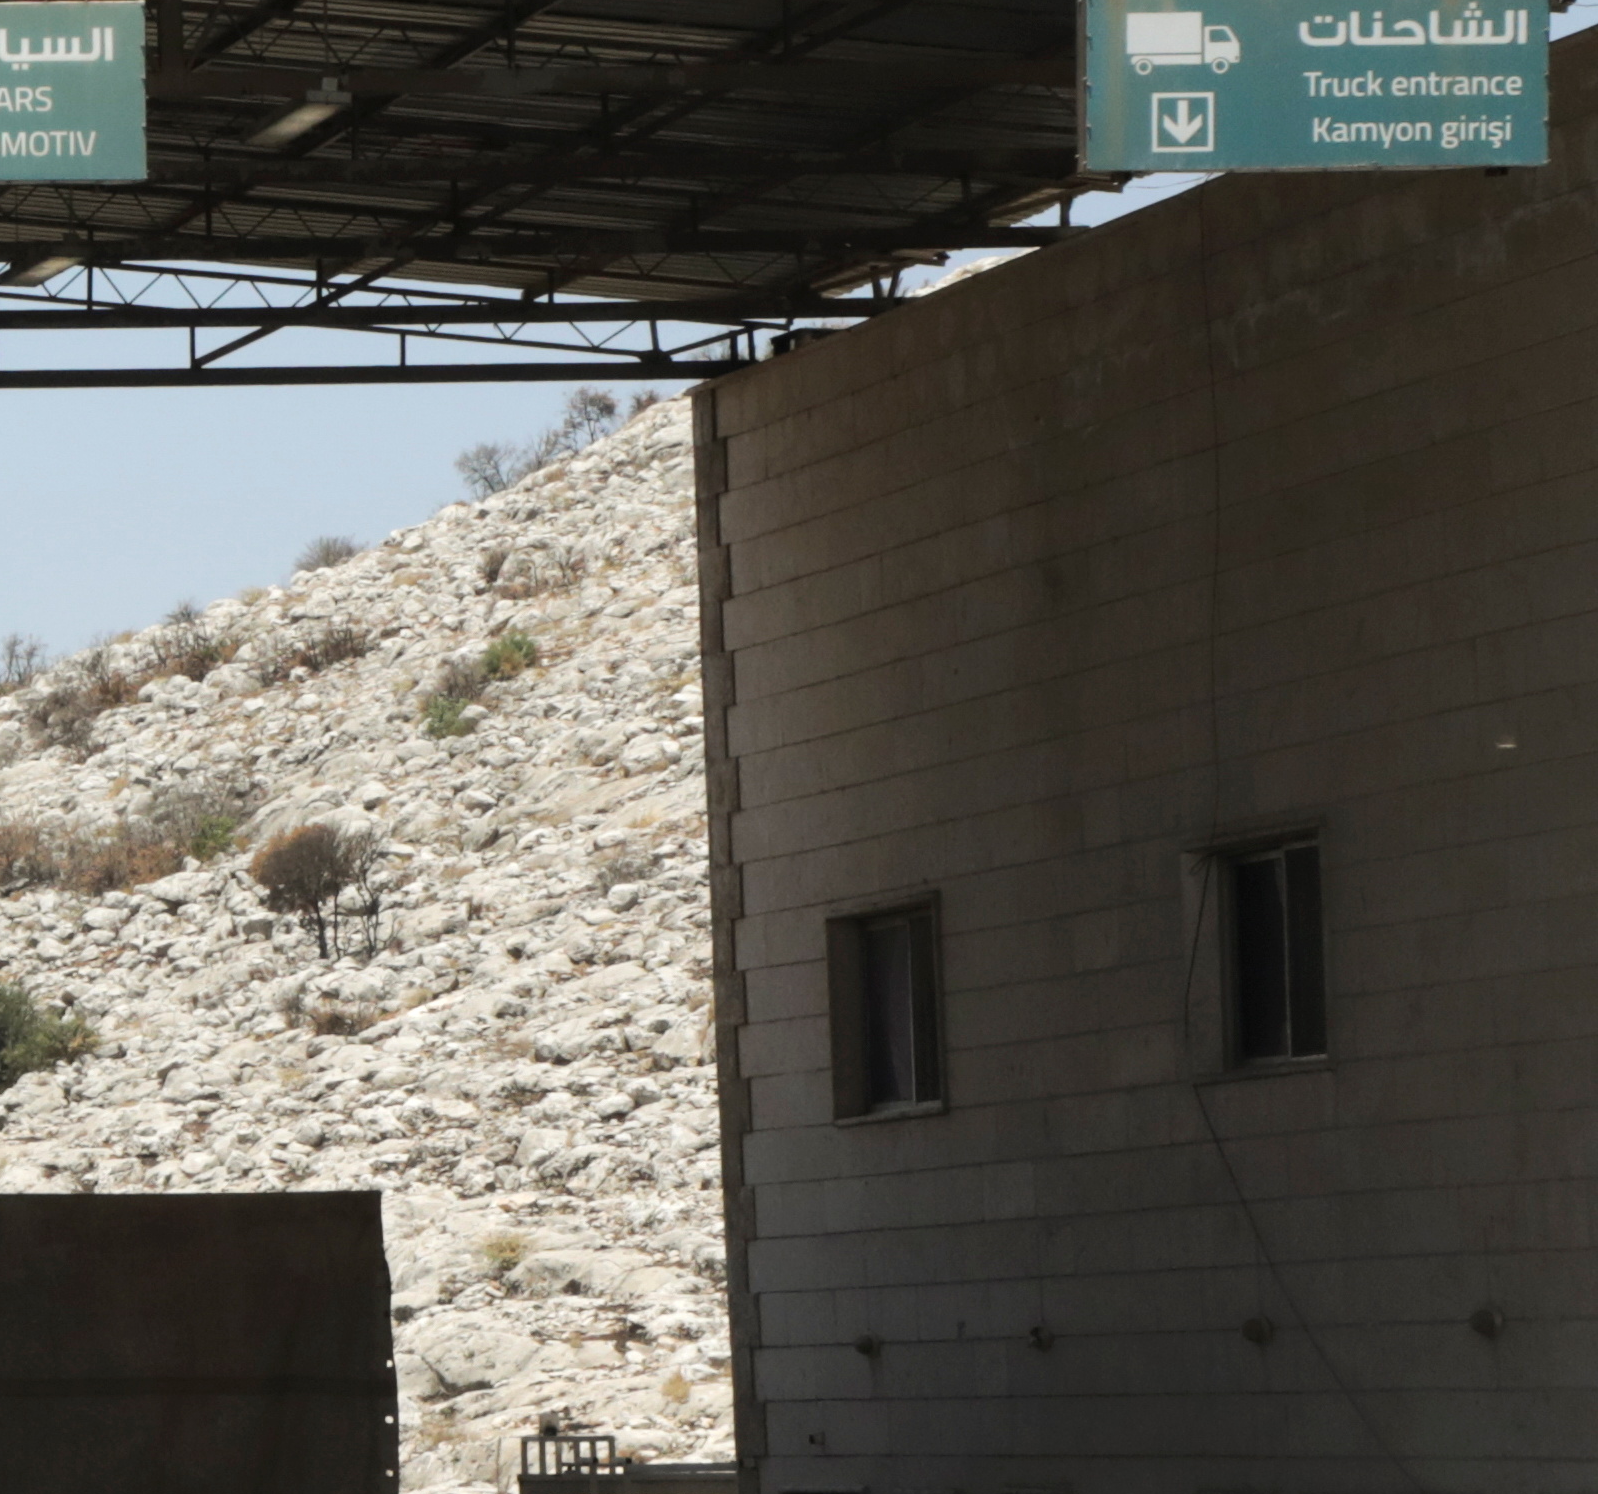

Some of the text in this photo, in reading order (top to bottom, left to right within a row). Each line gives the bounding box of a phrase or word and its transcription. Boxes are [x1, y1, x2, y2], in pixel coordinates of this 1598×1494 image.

[1299, 1, 1528, 46] الشاحنات
[1304, 70, 1523, 98] Truck entrance
[1312, 114, 1512, 149] Kamyon girişi
